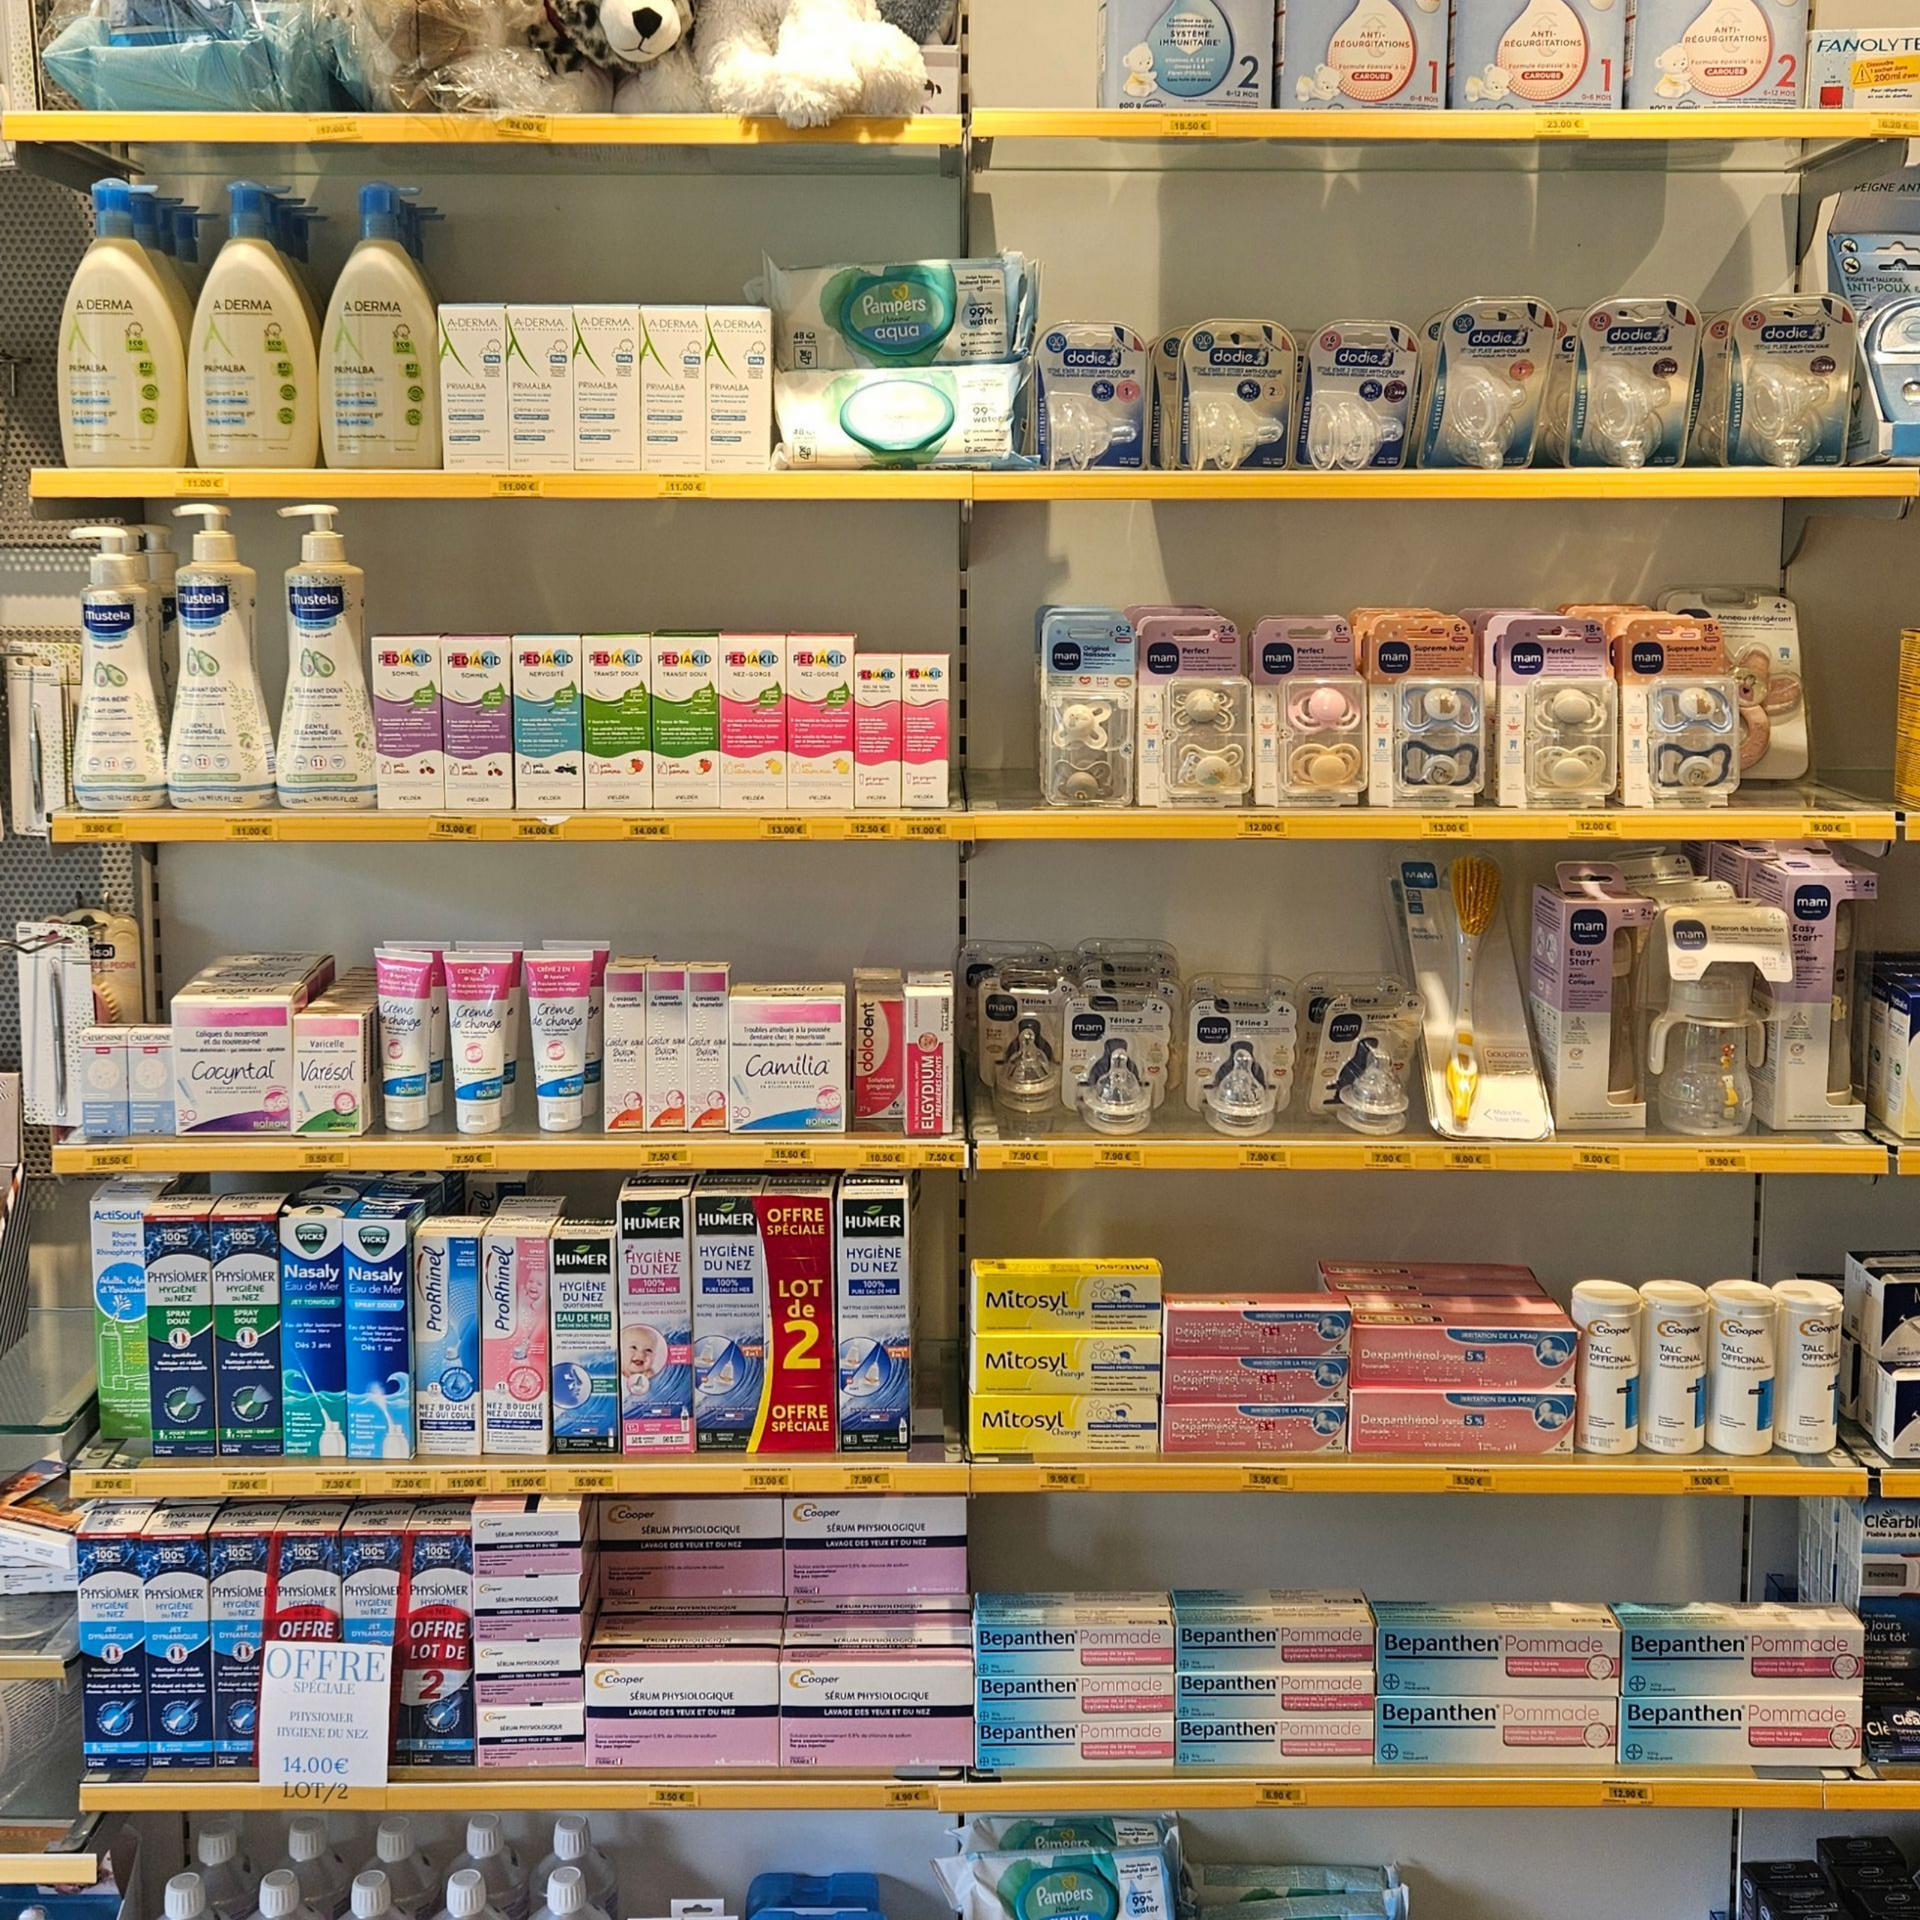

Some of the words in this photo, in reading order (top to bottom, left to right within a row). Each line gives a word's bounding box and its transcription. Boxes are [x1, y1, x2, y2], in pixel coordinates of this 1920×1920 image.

[1170, 29, 1210, 38] SYSTÈME
[1531, 30, 1557, 39] ANTI-
[1713, 26, 1741, 35] ANTI-
[1334, 39, 1410, 49] RÉGURGITATIONS
[1504, 38, 1582, 48] RÉGURGITATIONS
[1685, 33, 1767, 44] RÉGURGITATIONS
[1238, 55, 1259, 89] 2
[1705, 68, 1747, 76] CAROUBE
[1777, 54, 1796, 87] 2
[1352, 73, 1392, 81] CAROUBE
[1429, 61, 1437, 93] 1
[1780, 90, 1797, 98] MOIS
[1546, 120, 1572, 129] 23.00
[1571, 120, 1581, 129] €
[863, 296, 926, 317] Pampers
[969, 307, 992, 317] 99%
[969, 317, 999, 326] water
[792, 332, 805, 341] 48
[874, 325, 919, 341] aqua
[1474, 331, 1514, 345] dodie
[1765, 327, 1805, 340] dodie
[1067, 353, 1106, 365] dodie
[1214, 351, 1253, 364] dodie
[577, 382, 619, 390] PRIMALBA
[291, 594, 340, 604] Mustela
[85, 611, 131, 621] Mustela
[1717, 614, 1749, 623] Anneau
[1750, 614, 1791, 624] réfrigérant
[1115, 625, 1132, 634] 0-2
[1219, 625, 1235, 634] 2-6
[1584, 623, 1601, 634] 18+
[1082, 646, 1111, 655] Original
[1181, 647, 1211, 656] Perfect
[1414, 645, 1446, 654] Supreme
[1448, 645, 1466, 653] Nuit
[378, 654, 432, 666] PEDIAKID
[519, 654, 573, 666] PEDIAKID
[589, 654, 642, 666] PEDIAKID
[1054, 652, 1079, 661] mam
[1150, 654, 1177, 664] mam
[1513, 653, 1540, 663] mam
[909, 826, 935, 835] 11.00
[935, 826, 943, 835] €
[1249, 823, 1272, 832] 12.00
[1273, 824, 1281, 833] €
[1573, 921, 1603, 933] mam
[1711, 924, 1736, 933] Biberon
[1737, 925, 1749, 934] de
[1749, 926, 1785, 935] transition
[1569, 948, 1593, 958] Easy
[538, 1004, 574, 1015] Crème
[531, 1017, 543, 1026] de
[545, 1018, 582, 1032] change
[1109, 1016, 1136, 1025] Tétine
[1234, 1019, 1262, 1027] Tétine
[1075, 1022, 1102, 1033] mam
[195, 1031, 222, 1039] Coliques
[858, 1002, 874, 1071] dolodent
[221, 1038, 262, 1046] nouveau-né
[309, 1040, 345, 1048] Varicelle
[301, 1060, 355, 1081] Varésol
[746, 1055, 828, 1077] Camilia
[192, 1060, 275, 1085] Cocyntal
[921, 1055, 935, 1129] ELGYDIUM
[775, 1150, 799, 1159] 15.60
[799, 1150, 807, 1159] €
[767, 1208, 823, 1223] OFFRE
[624, 1216, 680, 1230] HUMER
[846, 1215, 900, 1229] HUMER
[767, 1222, 824, 1235] SPÉCIALE
[111, 1231, 137, 1239] Rhume
[297, 1233, 325, 1241] VICKS
[360, 1236, 388, 1244] VICKS
[847, 1246, 901, 1260] HYGIÈNE
[556, 1253, 607, 1266] HUMER
[148, 1269, 208, 1283] PHYSIOMER
[285, 1265, 339, 1280] Nasaly
[348, 1268, 402, 1283] Nasaly
[159, 1284, 197, 1293] HYGIÈNE
[285, 1282, 301, 1291] Eau
[304, 1282, 315, 1291] de
[317, 1282, 340, 1291] Mer
[426, 1245, 445, 1332] ProRhinel
[559, 1281, 606, 1292] HYGIÈNE
[778, 1279, 822, 1297] LOT
[174, 1294, 193, 1303] NEZ
[986, 1291, 1068, 1311] Mitosyl
[165, 1310, 191, 1318] SPRAY
[788, 1299, 814, 1318] de
[1056, 1309, 1084, 1318] Change
[166, 1318, 191, 1326] DOUX
[556, 1314, 574, 1323] EAU
[575, 1314, 587, 1323] DE
[588, 1314, 610, 1323] MER
[1596, 1325, 1631, 1336] Cooper
[783, 1321, 821, 1369] 2
[1590, 1344, 1611, 1353] TALC
[1362, 1349, 1439, 1360] Dexpanthénol
[1590, 1353, 1631, 1363] OFFICINAL
[418, 1403, 435, 1411] NEZ
[437, 1402, 476, 1411] BOUCHÉ
[772, 1405, 828, 1419] OFFRE
[982, 1411, 1064, 1430] Mitosyl
[1361, 1414, 1438, 1425] Dexpanthénol
[771, 1419, 829, 1432] SPÉCIALE
[410, 1623, 465, 1638] OFFRE
[980, 1630, 1074, 1648] Bepanthen
[1081, 1630, 1161, 1644] Pommade
[1181, 1629, 1276, 1646] Bepanthen
[1281, 1628, 1362, 1642] Pommade
[1631, 1635, 1745, 1655] Bepanthen
[1750, 1636, 1848, 1651] Pommade
[411, 1645, 438, 1659] LOT
[446, 1645, 465, 1659] DE
[266, 1648, 385, 1682] OFFRE
[419, 1671, 444, 1699] 2
[605, 1673, 644, 1686] Cooper
[293, 1679, 355, 1695] SPÉCIALE
[630, 1691, 659, 1700] SÉRUM
[662, 1690, 734, 1701] PHYSIOLOGIQUE
[290, 1712, 353, 1723] PHYSIOMER
[277, 1727, 325, 1737] HYGIENE
[328, 1728, 342, 1738] DU
[345, 1729, 368, 1739] NEZ
[283, 1757, 348, 1774] 14.00€
[283, 1783, 348, 1803] LOT/2
[1613, 1789, 1635, 1798] 12.90
[1638, 1789, 1643, 1798] €
[1037, 1887, 1093, 1904] Pampers
